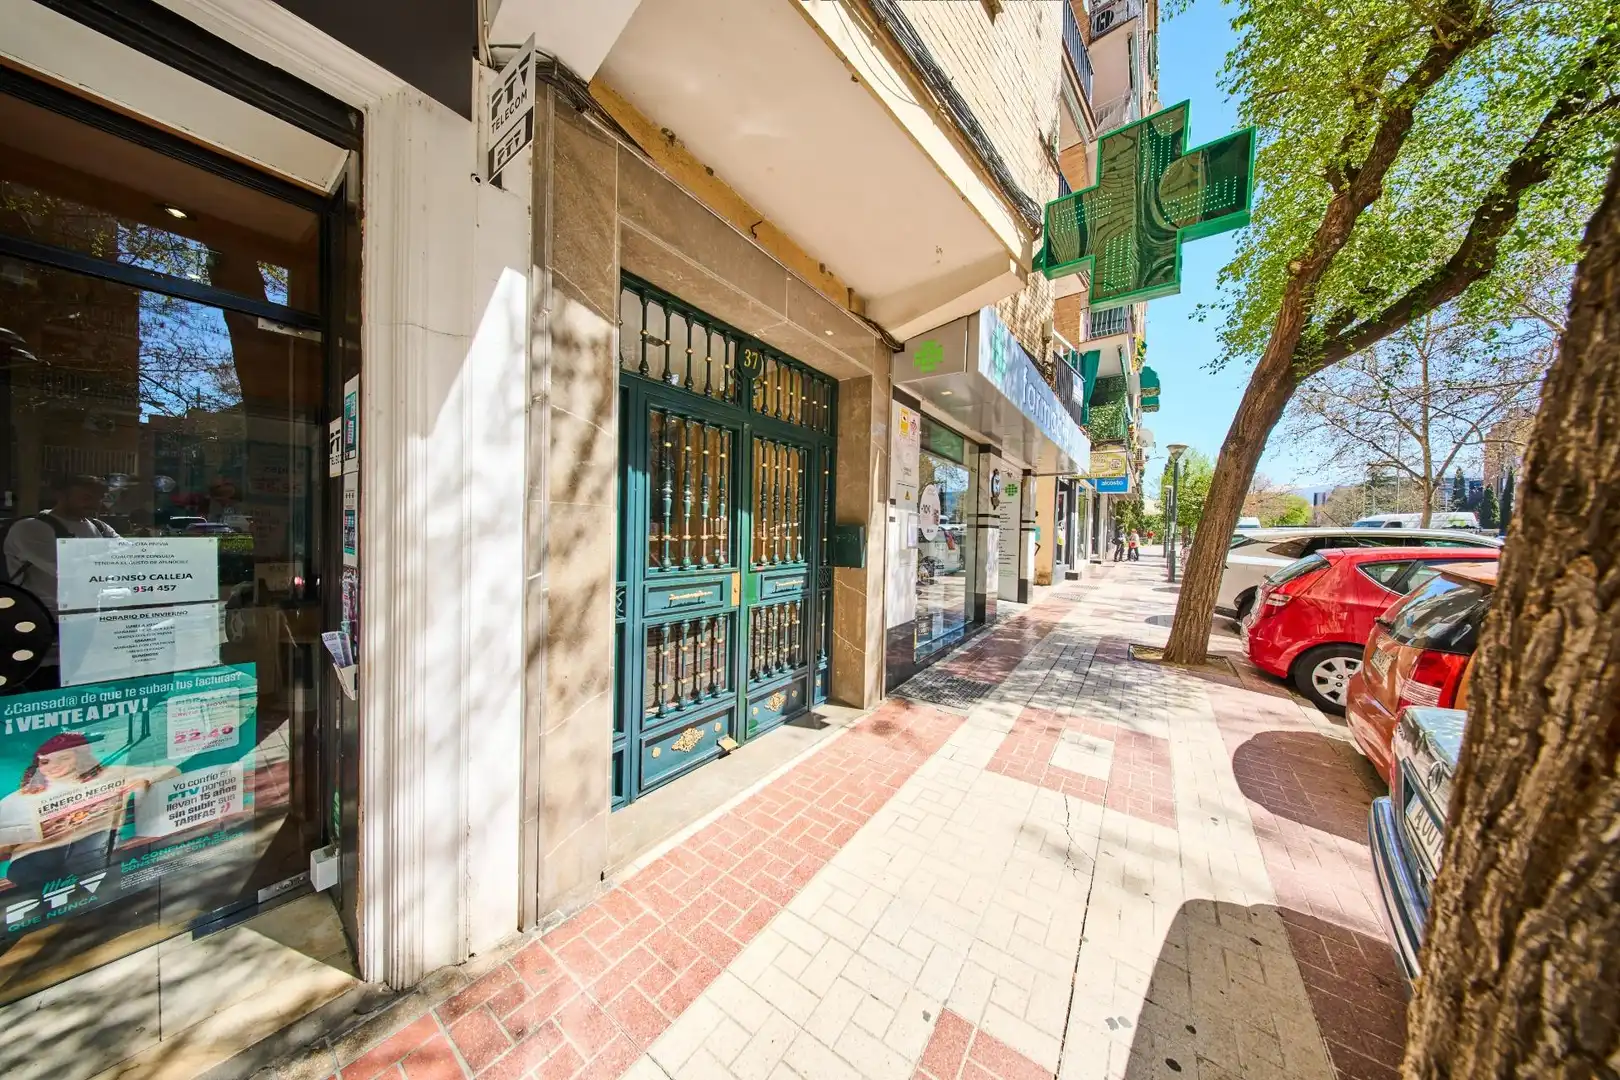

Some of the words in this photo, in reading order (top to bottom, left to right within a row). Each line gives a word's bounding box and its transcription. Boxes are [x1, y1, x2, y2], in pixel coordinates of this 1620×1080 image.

[491, 52, 532, 121] PTV
[491, 88, 528, 134] TELECOM
[497, 129, 522, 167] PTV
[744, 349, 758, 369] 37
[89, 574, 146, 582] ALFONSO
[133, 585, 154, 593] 954
[157, 584, 177, 592] 457
[99, 613, 138, 622] HORARIO
[151, 610, 189, 618] INVIERNO
[81, 692, 97, 704] de
[100, 689, 122, 703] que
[125, 687, 137, 698] te
[139, 682, 174, 696] suban
[175, 679, 193, 690] tus
[195, 671, 242, 687] facturas?
[86, 705, 100, 721] A
[102, 697, 149, 718] PTV!
[167, 786, 200, 802] PTV
[201, 776, 237, 793] porque
[173, 782, 186, 791] Yo
[187, 772, 219, 787] confío
[38, 793, 83, 814] ¡ENERO
[85, 779, 126, 797] NEGRO!
[166, 797, 198, 812] llevan
[199, 791, 211, 801] 15
[212, 784, 237, 796] años
[168, 810, 186, 821] sin
[187, 799, 216, 814] subir
[174, 808, 216, 828] TARIFAS
[121, 858, 138, 868] LA
[141, 836, 212, 861] CONFIANZA
[6, 871, 107, 925] PTV
[7, 915, 42, 932] QUE
[46, 894, 99, 919] NUNCA
